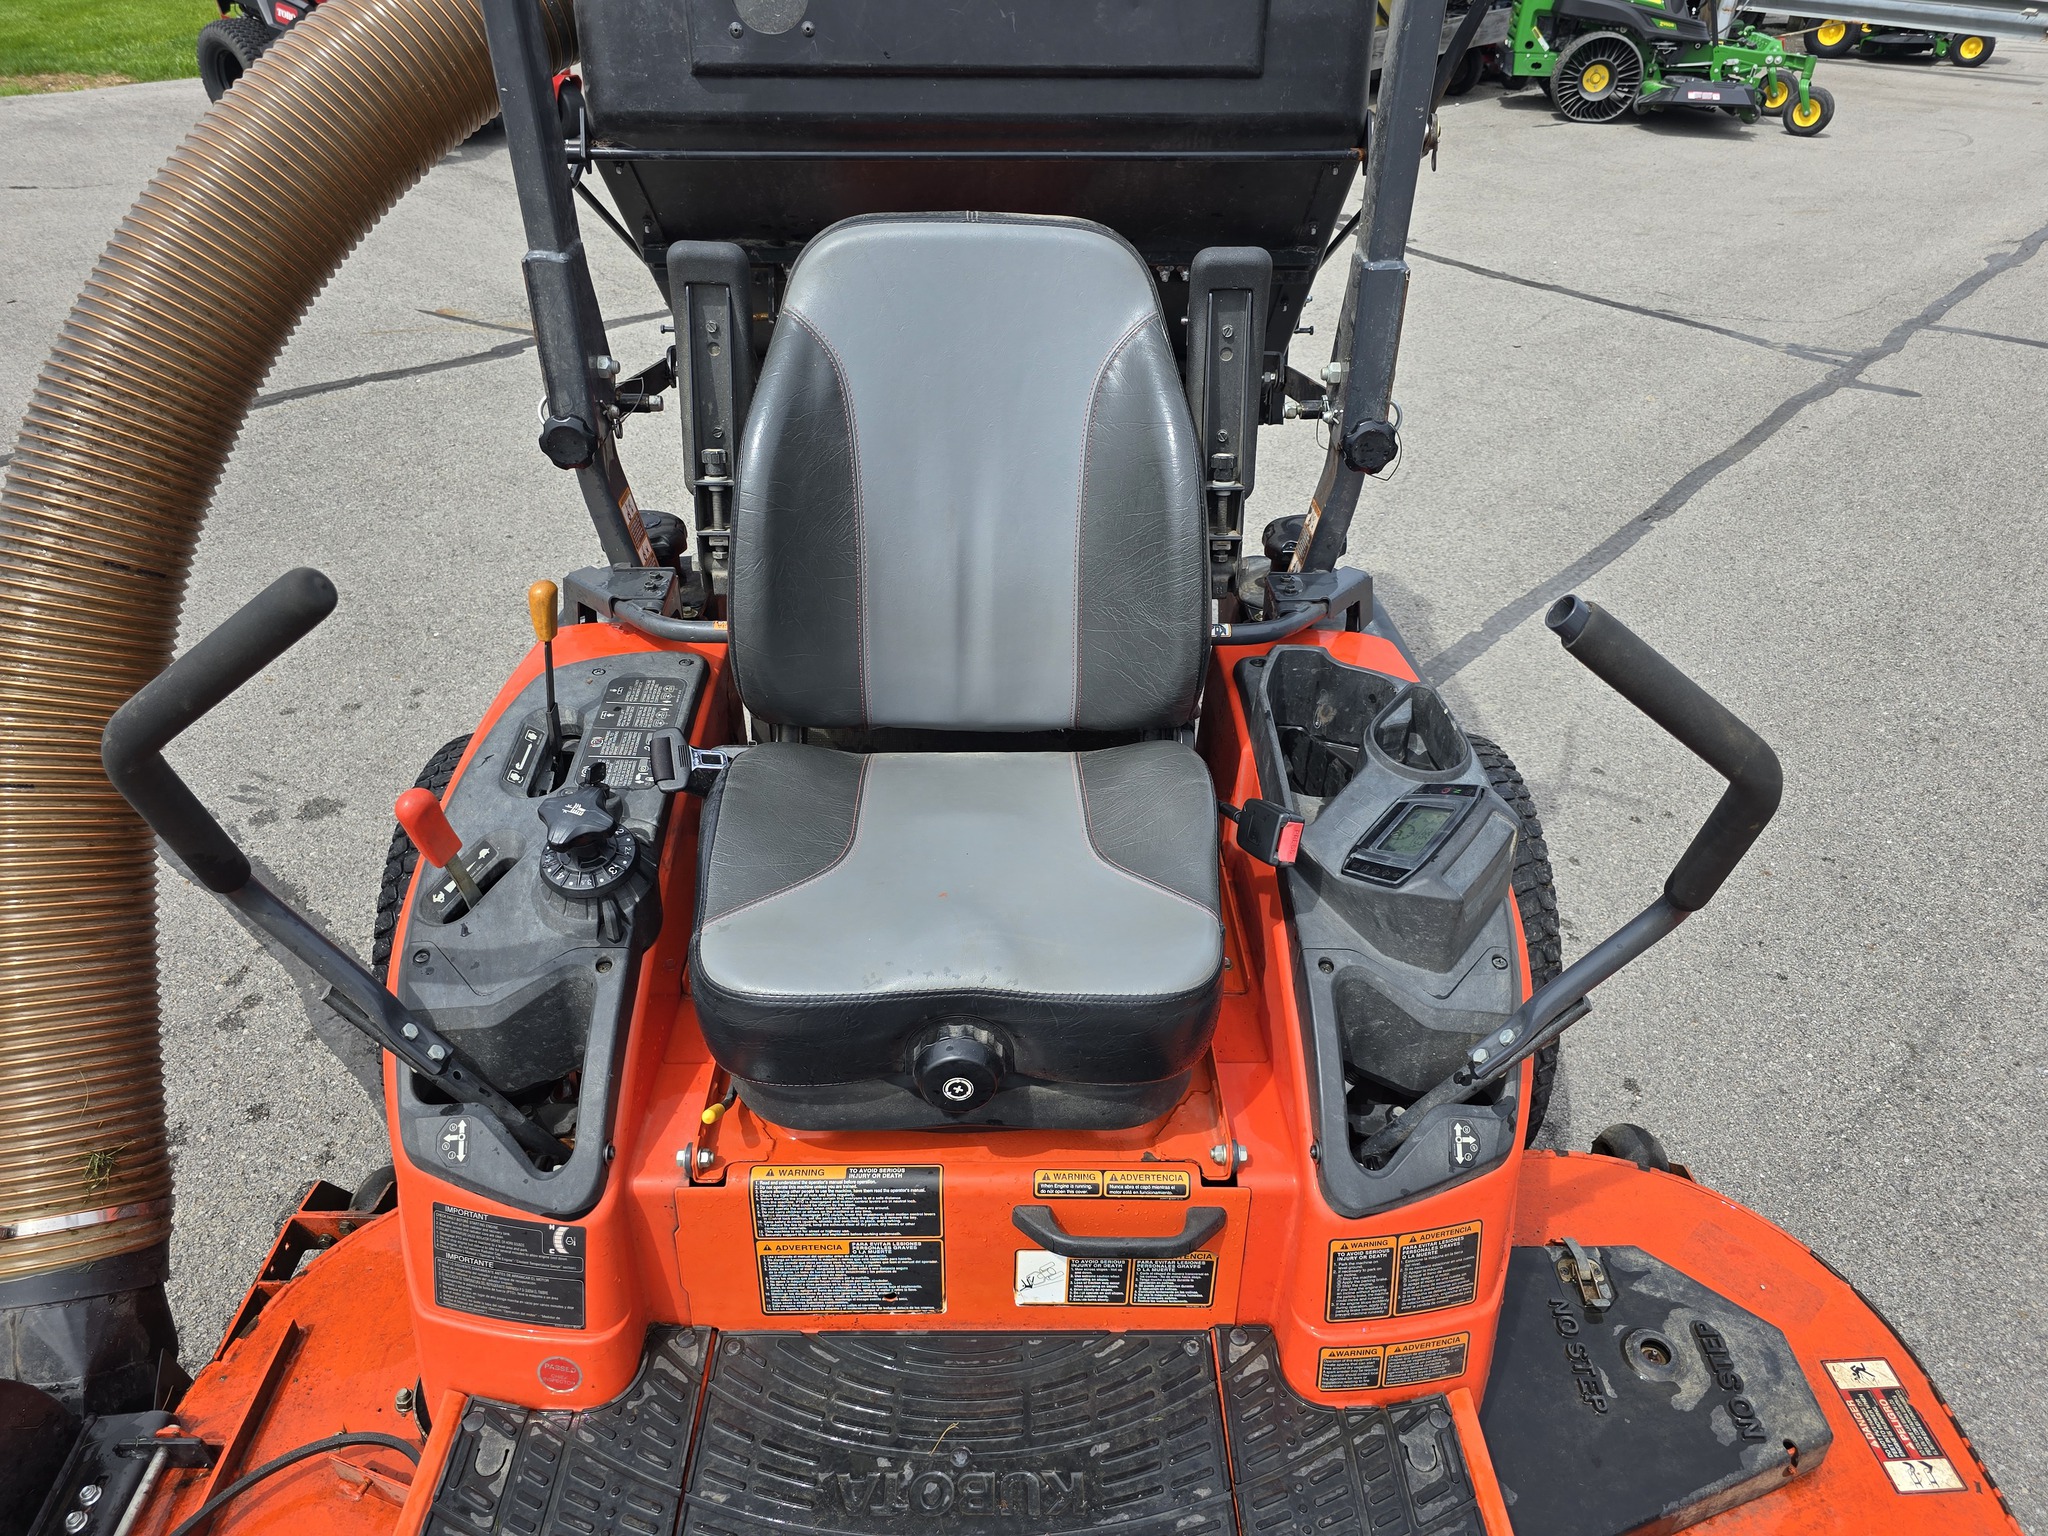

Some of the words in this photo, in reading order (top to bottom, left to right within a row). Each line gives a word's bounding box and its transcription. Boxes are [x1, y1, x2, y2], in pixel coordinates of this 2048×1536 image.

[556, 871, 565, 880] 4
[608, 866, 618, 875] 3
[778, 1169, 825, 1177] WARNING
[1053, 1173, 1096, 1181] WARNING
[1120, 1174, 1184, 1182] ADVERTENCIA
[445, 1205, 489, 1221] IMPORTANT
[1419, 1225, 1472, 1241] ADVERTENCIA
[1350, 1240, 1388, 1249] WARNING
[1438, 1236, 1464, 1245] LESIONES
[1402, 1246, 1438, 1255] PERSONALES
[1416, 1250, 1438, 1258] MUERTE
[445, 1252, 494, 1269] IMPORTANTE
[1402, 1336, 1461, 1352] ADVERTENCIA
[1336, 1348, 1378, 1357] WARNING
[1547, 1297, 1580, 1338] NO
[1565, 1341, 1609, 1415] STEP
[1688, 1320, 1744, 1394] STEP
[1726, 1395, 1767, 1444] NO
[1845, 1399, 1875, 1442] DANGER
[1879, 1398, 1910, 1441] PELIGRO
[837, 1470, 1087, 1518] KUBOTA
